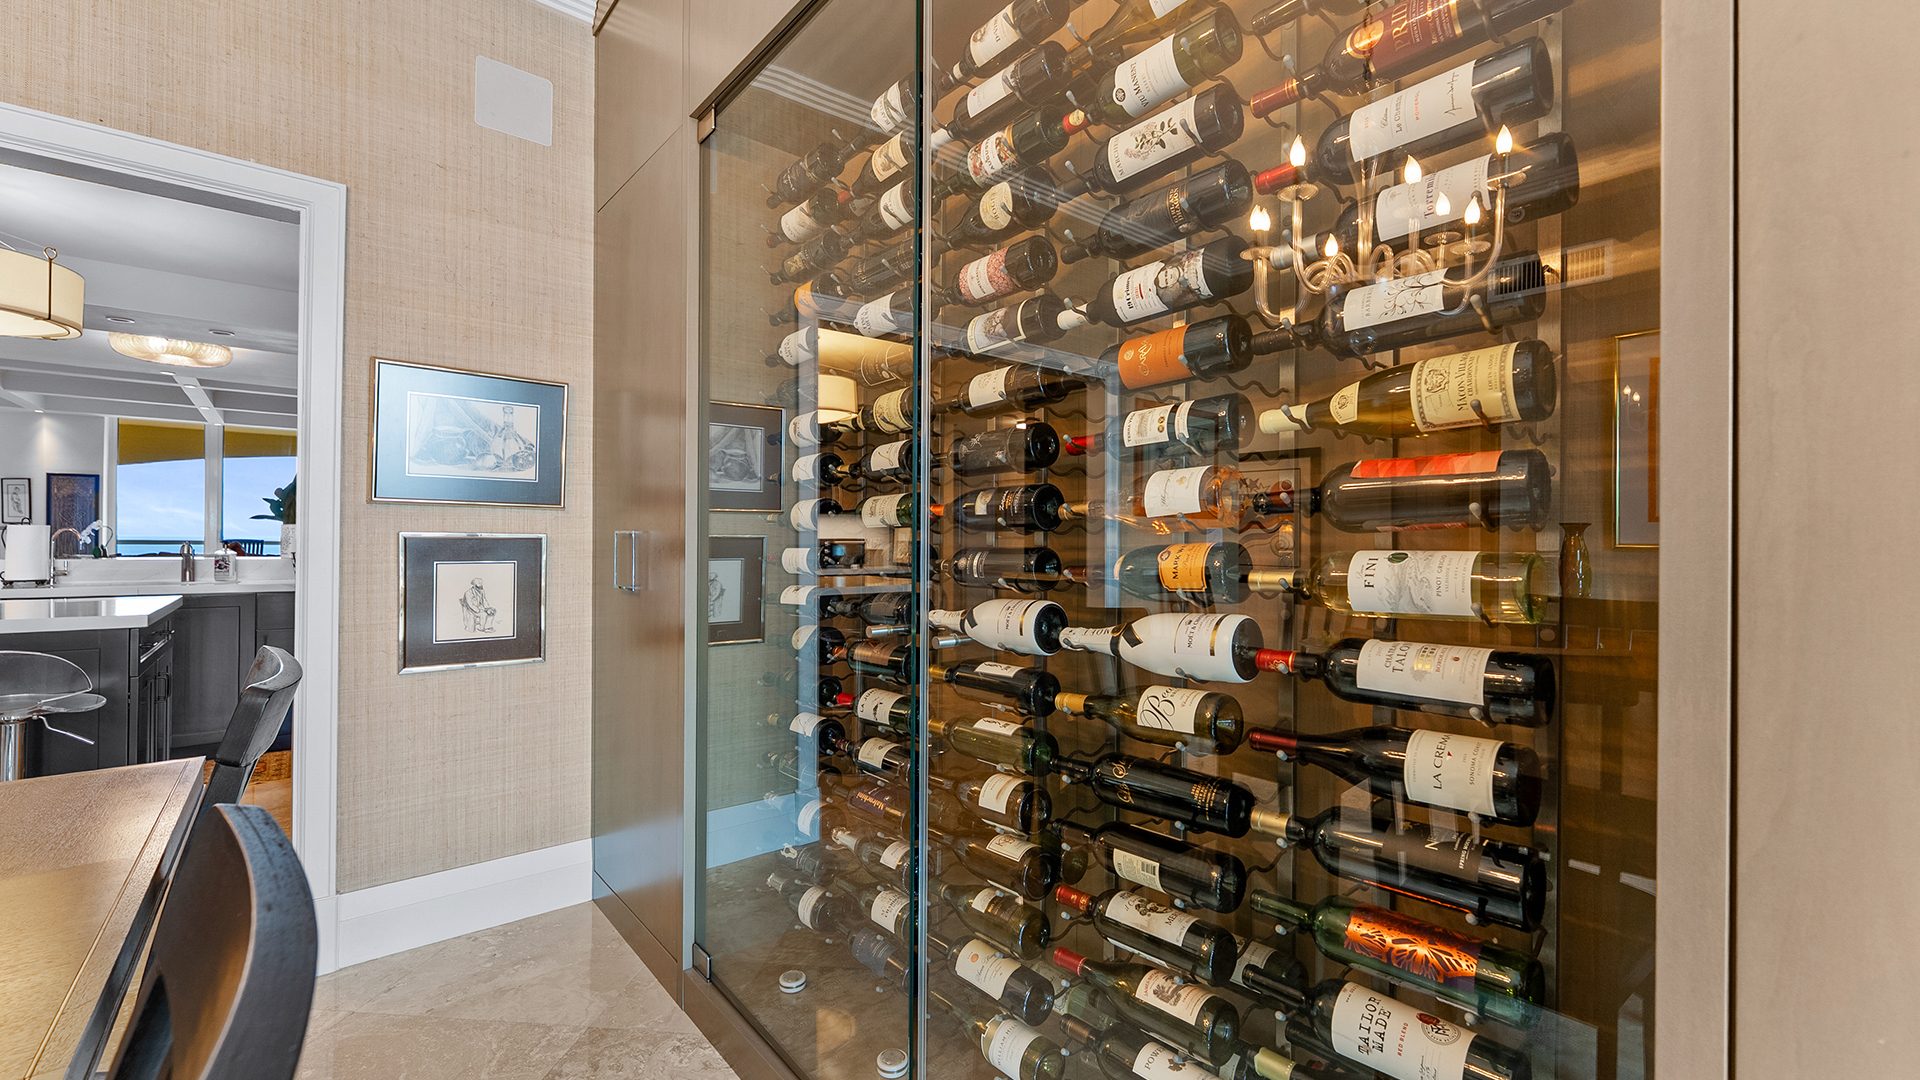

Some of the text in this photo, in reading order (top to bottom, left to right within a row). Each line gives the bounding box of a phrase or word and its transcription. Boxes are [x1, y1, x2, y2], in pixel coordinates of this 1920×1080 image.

[1138, 93, 1150, 107] VIU
[1364, 557, 1379, 589] FINI
[1433, 772, 1443, 790] LA
[1468, 758, 1477, 785] SONOMA
[1357, 996, 1381, 1056] TAILOR
[1371, 1009, 1392, 1053] MADE
[1399, 1022, 1409, 1041] BLEND
